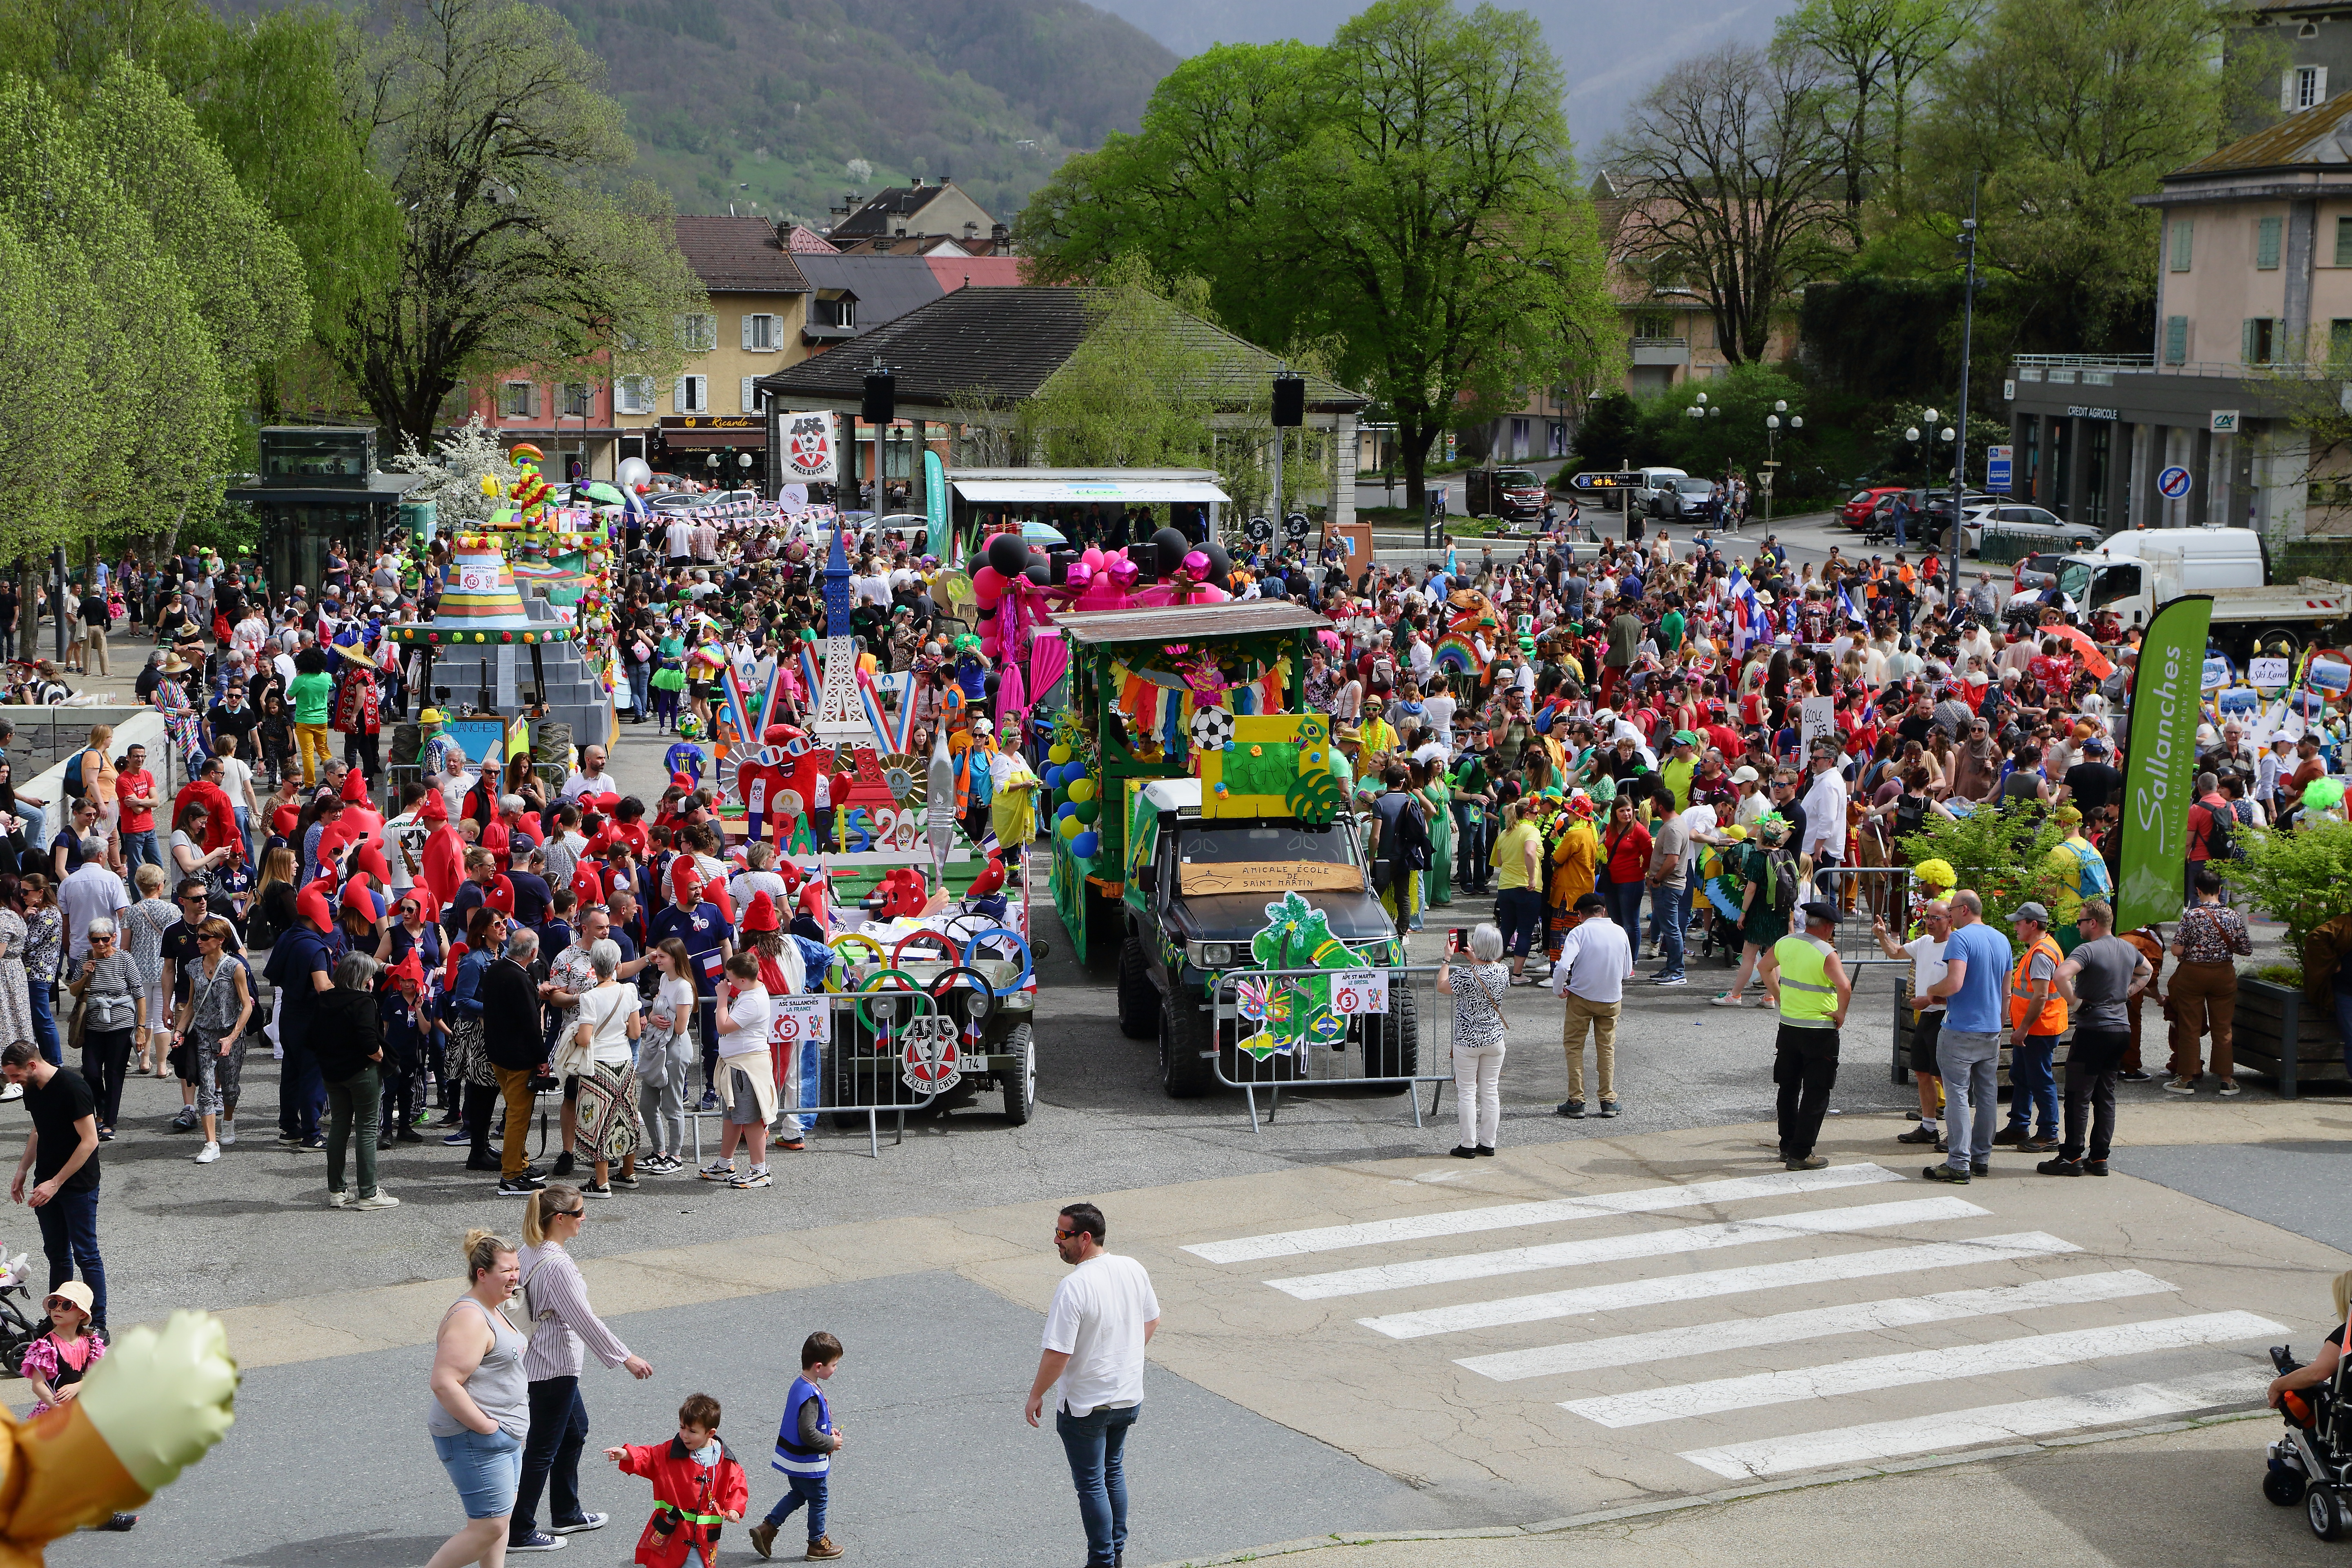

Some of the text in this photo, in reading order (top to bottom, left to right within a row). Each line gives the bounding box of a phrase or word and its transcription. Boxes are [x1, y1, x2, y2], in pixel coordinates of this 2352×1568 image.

[2068, 405, 2117, 420] CRÉDIT AGRICOLE
[790, 417, 826, 435] ASC
[790, 460, 832, 475] SALLANCHES
[933, 467, 944, 541] Sallanches
[1437, 638, 1478, 666] IRISH KOTOSS
[2252, 670, 2288, 681] Ski Land
[1805, 704, 1823, 723] ÉCOLE
[1813, 724, 1827, 738] DES
[2179, 730, 2185, 743] DU
[2137, 645, 2180, 854] Sallanches
[678, 759, 690, 773] 10
[2176, 750, 2184, 777] PAYS
[2174, 784, 2181, 797] AU
[2171, 804, 2179, 837] VILLE
[772, 804, 870, 857] PARIS
[2168, 844, 2175, 857] LA
[1297, 865, 1329, 874] ÉCOLE
[1368, 988, 1382, 997] CAR
[1370, 995, 1381, 1003] NA
[1345, 996, 1352, 1007] 3
[1369, 1002, 1383, 1011] VAL
[809, 1015, 824, 1024] CAR
[811, 1022, 822, 1030] NA
[784, 1023, 791, 1034] 5
[810, 1029, 824, 1038] VAL
[905, 1018, 955, 1038] ASC
[966, 1058, 980, 1069] 74
[905, 1073, 958, 1091] SALLACHES
